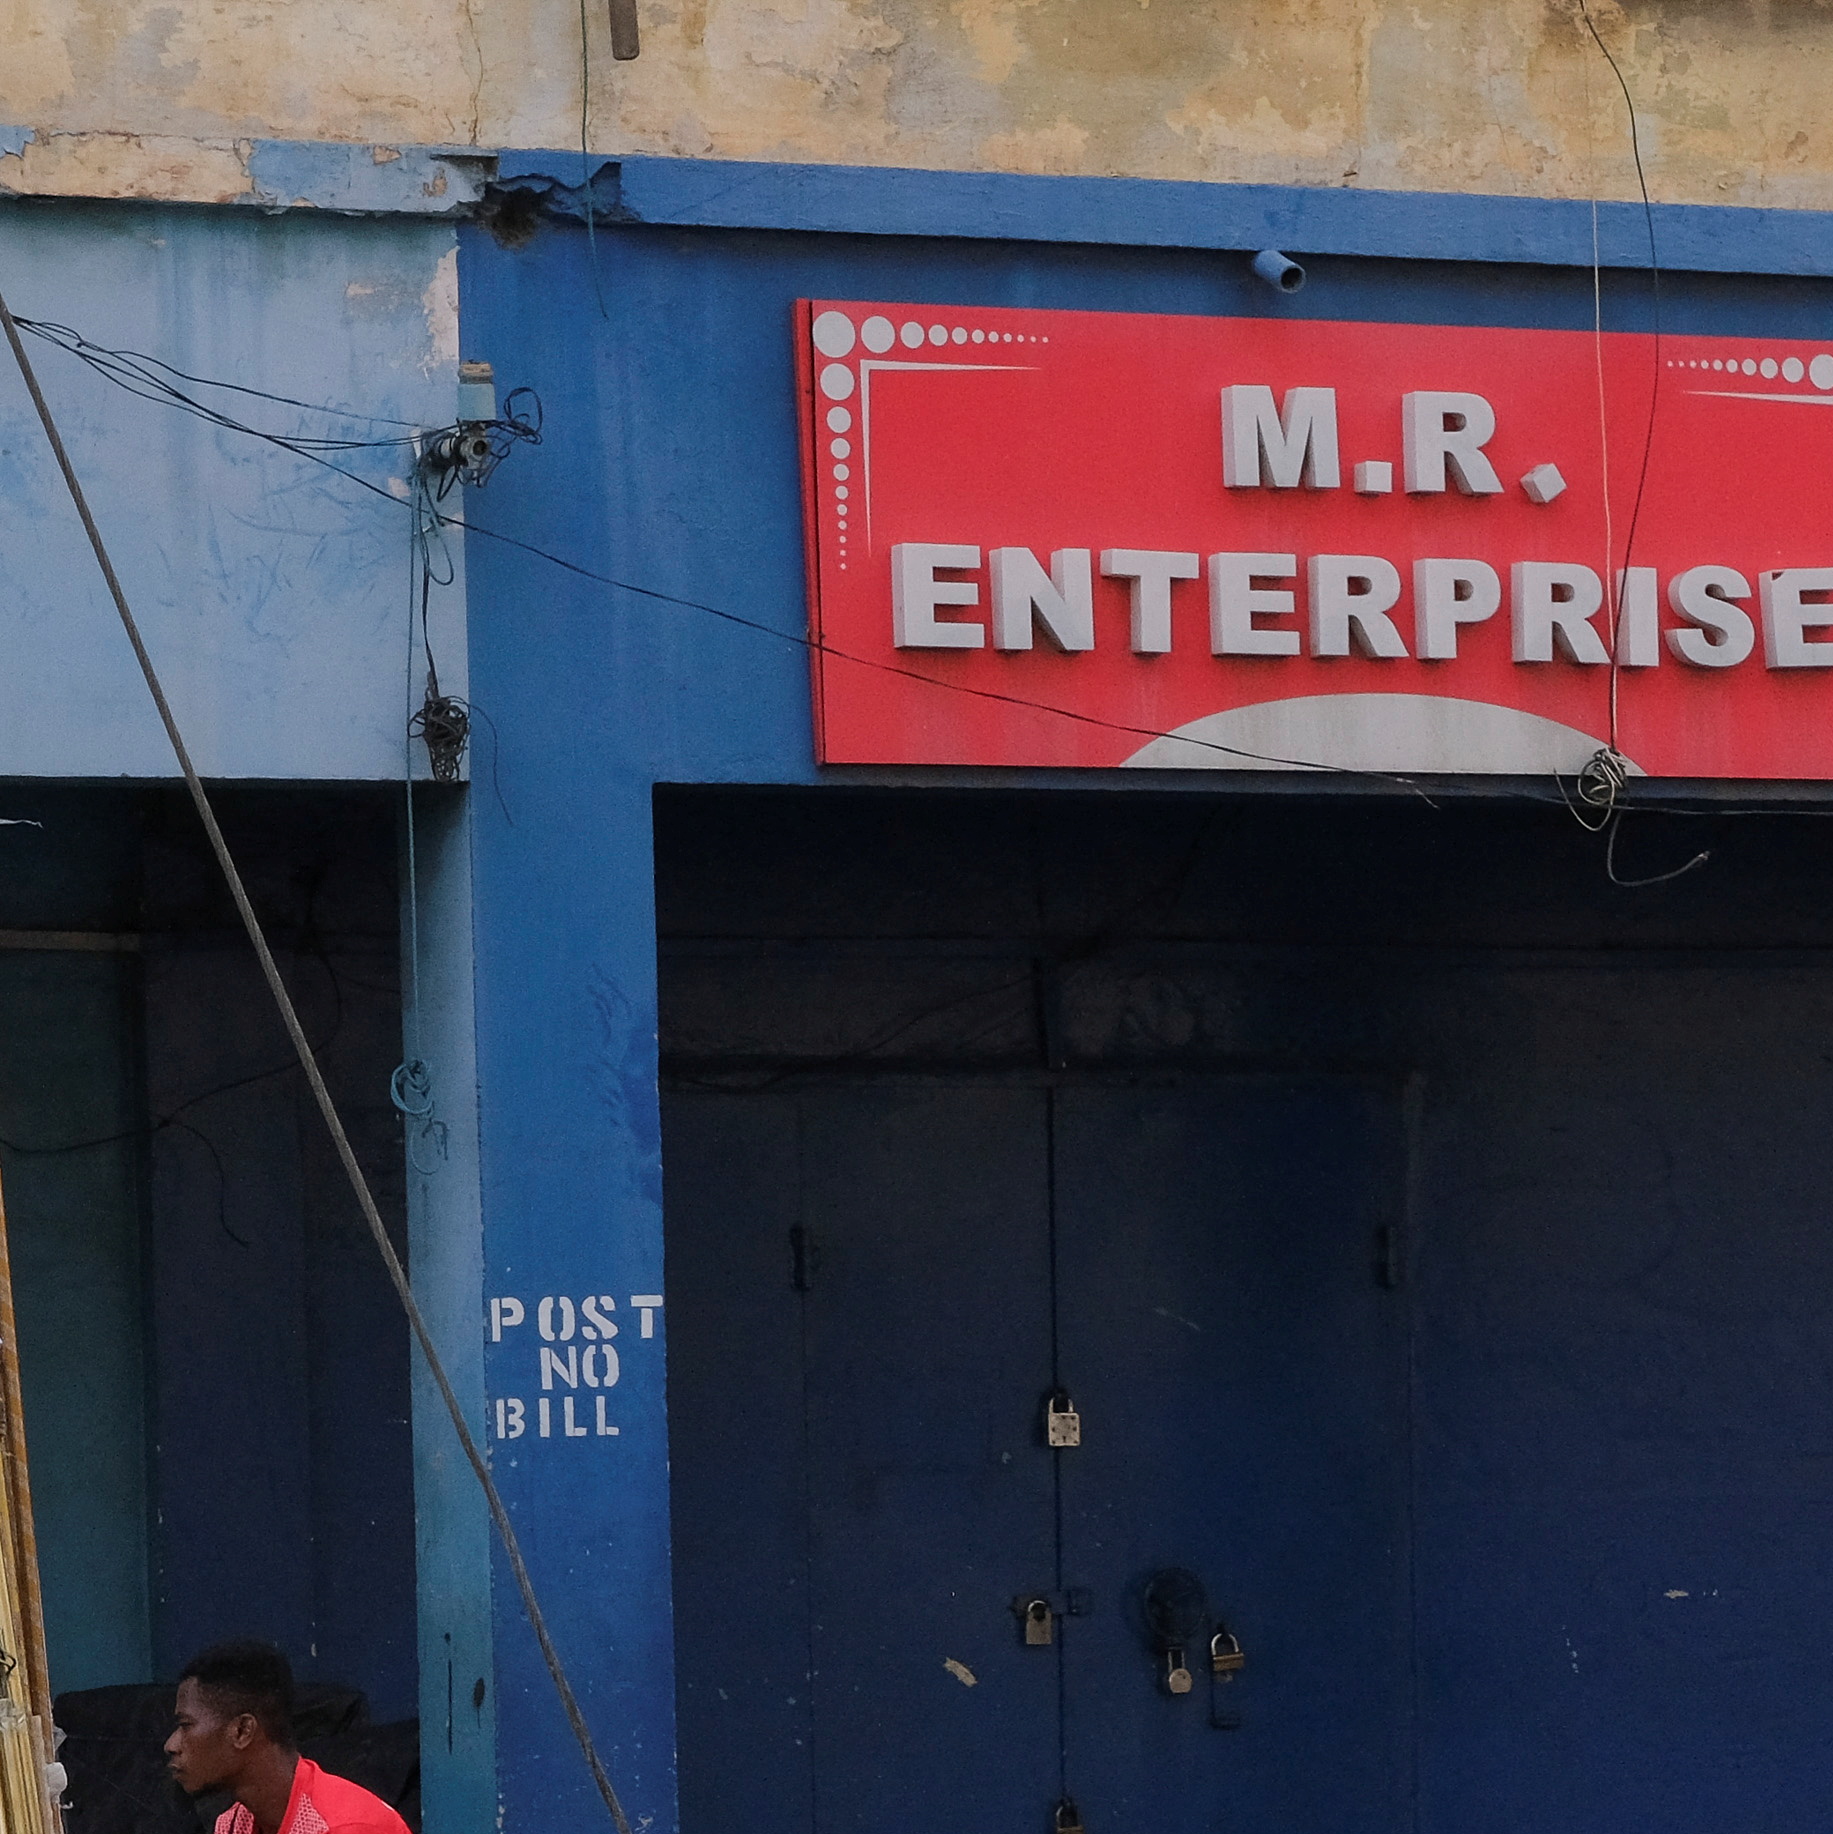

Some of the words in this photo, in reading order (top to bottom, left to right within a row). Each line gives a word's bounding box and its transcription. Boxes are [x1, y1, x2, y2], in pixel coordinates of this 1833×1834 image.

[1220, 385, 1566, 504] M.R.
[490, 1294, 664, 1342] POST
[540, 1343, 620, 1390] NO
[495, 1395, 620, 1439] BILL
